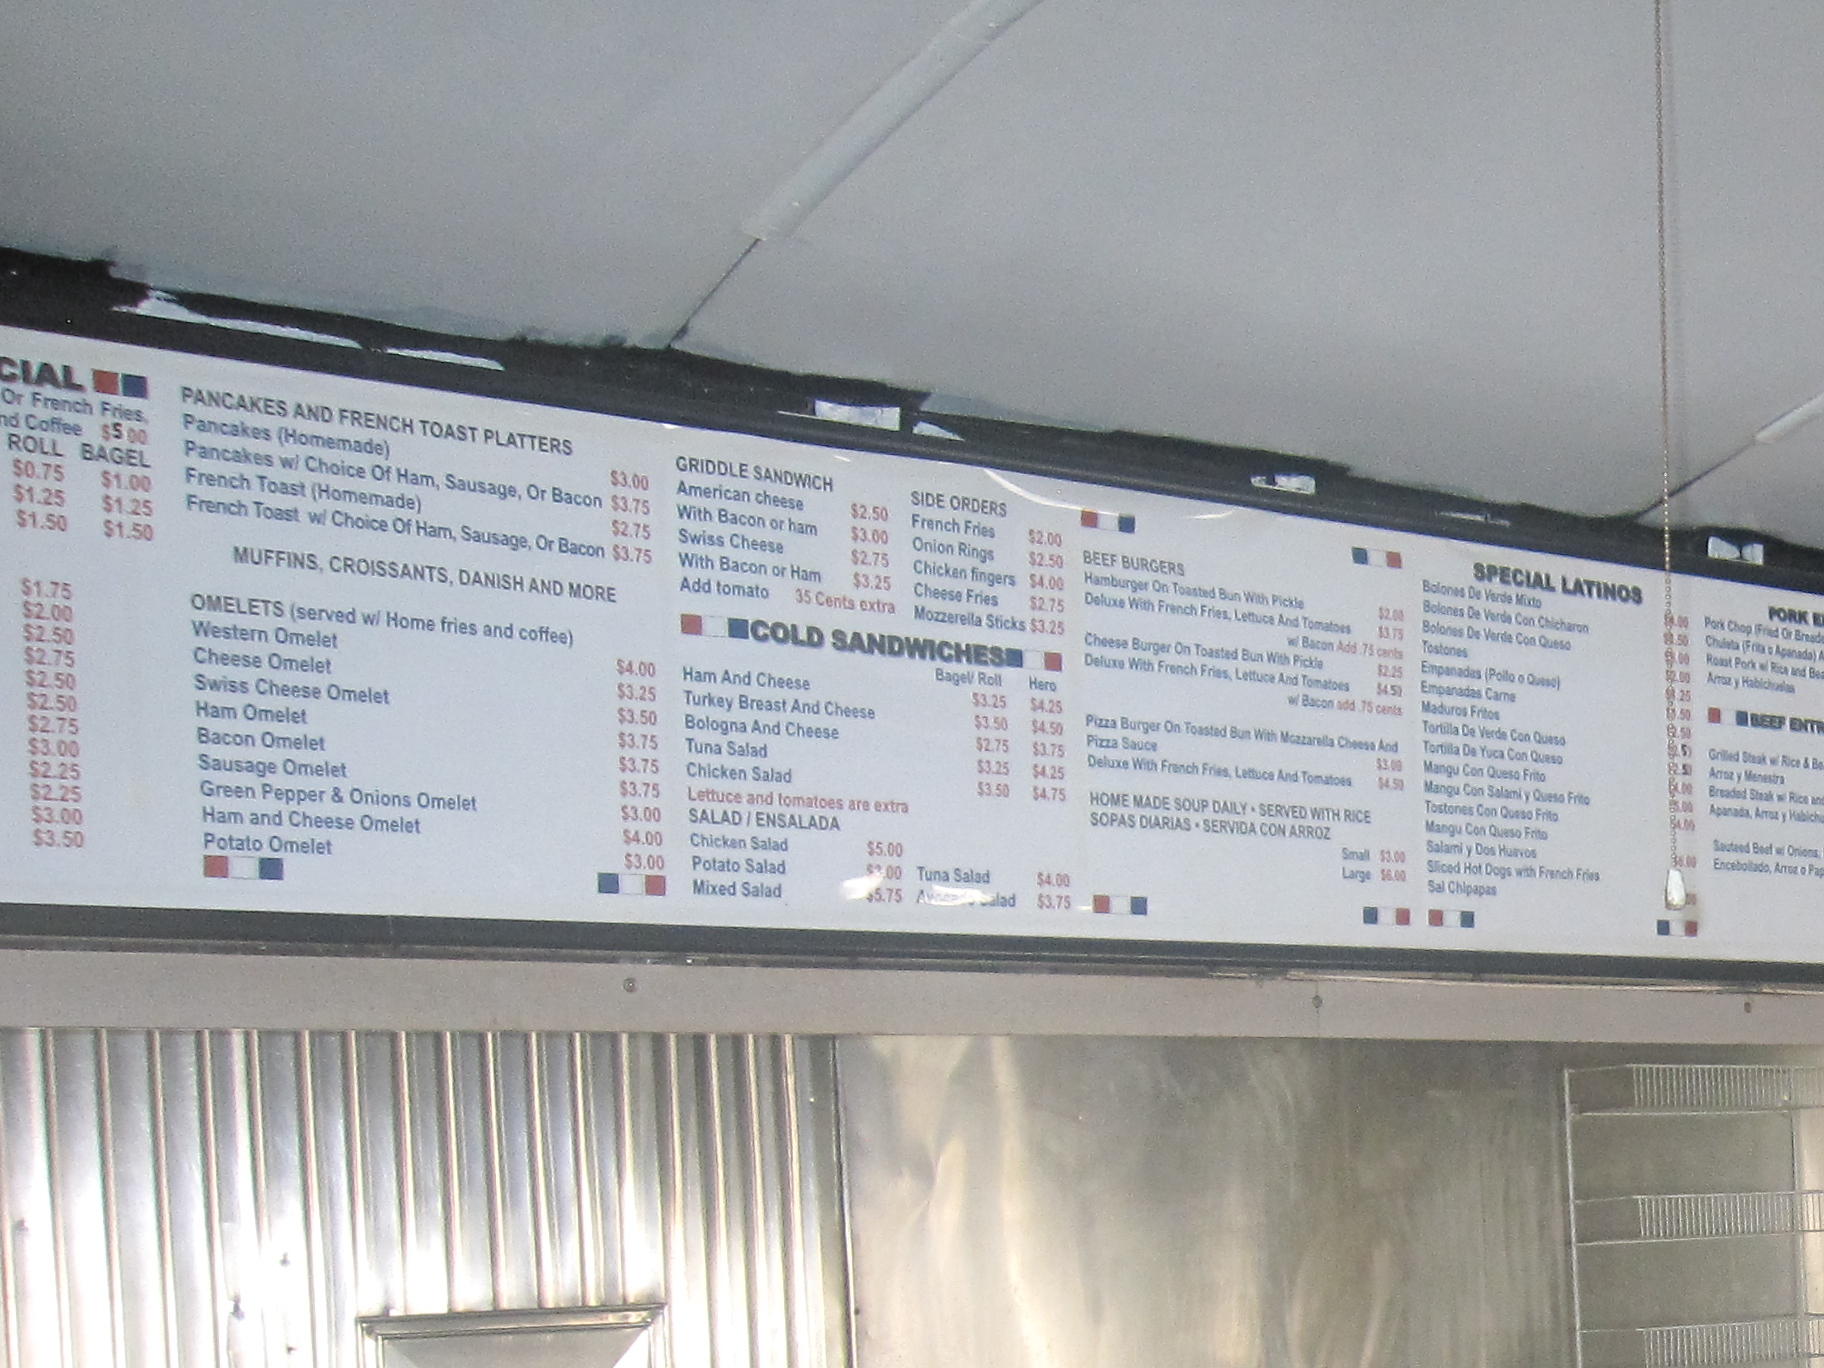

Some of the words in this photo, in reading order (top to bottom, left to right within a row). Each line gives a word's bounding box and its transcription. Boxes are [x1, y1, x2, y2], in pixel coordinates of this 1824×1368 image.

[0, 387, 25, 405] Or
[30, 391, 94, 415] French
[24, 413, 83, 436] Coffee
[180, 386, 289, 417] PANCAKES
[292, 402, 333, 423] AND
[338, 408, 414, 434] FRENCH
[418, 419, 478, 442] TOAST
[483, 428, 573, 456] PLATTERS
[7, 432, 64, 457] ROLL
[80, 442, 151, 468] BAGEL
[182, 413, 273, 441] Pancakes
[277, 427, 390, 459] (Homemade)
[609, 469, 649, 491] $3.00
[12, 458, 65, 482] $0.75
[100, 470, 152, 492] $1.00
[183, 439, 275, 467] Pancakes
[278, 454, 300, 470] w/
[304, 455, 366, 479] Choice
[370, 463, 392, 482] Of
[395, 467, 440, 490] Ham,
[444, 473, 522, 500] Sausage,
[526, 483, 547, 501] Or
[551, 486, 603, 508] Bacon
[610, 494, 650, 515] $3.75
[675, 455, 749, 479] GRIDDLE
[753, 465, 833, 491] SANDWICH
[12, 483, 65, 507] $1.25
[101, 494, 153, 517] $1.25
[184, 466, 252, 490] French
[255, 474, 306, 497] Toast
[311, 482, 422, 513] (Homemade)
[611, 519, 651, 540] $2.75
[676, 480, 751, 502] American
[754, 490, 804, 511] cheese
[850, 502, 889, 522] $2.50
[910, 490, 945, 509] SIDE
[949, 495, 1007, 517] ORDERS
[15, 508, 68, 532] $1.50
[103, 519, 154, 541] $1.50
[911, 513, 960, 533] French
[963, 519, 996, 539] Fries
[1027, 528, 1063, 547] $2.00
[678, 527, 725, 547] Swiss
[729, 533, 784, 554] Cheese
[850, 548, 890, 568] $2.75
[911, 536, 955, 555] Onion
[957, 541, 995, 564] Rings
[1028, 551, 1064, 569] $2.50
[1082, 549, 1117, 567] BEEF
[1121, 555, 1185, 576] BURGERS
[20, 577, 72, 600] $1.75
[232, 546, 323, 571] MUFFINS,
[328, 555, 453, 584] CROISSANTS,
[458, 569, 524, 591] DANISH
[528, 577, 564, 596] AND
[568, 582, 616, 603] MORE
[189, 593, 285, 617] OMELETS
[289, 603, 357, 624] (served
[361, 610, 381, 626] w/
[386, 611, 436, 632] Home
[440, 616, 478, 636] fries
[483, 623, 514, 639] and
[518, 626, 574, 647] coffee)
[190, 620, 269, 642] Western
[274, 626, 338, 648] Omelet
[616, 658, 656, 678] $4.00
[750, 619, 825, 649] COLD
[831, 630, 1006, 667] SANDWICHES
[192, 646, 263, 668] Cheese
[267, 652, 332, 674] Omelet
[617, 682, 656, 702] $3.25
[682, 666, 717, 683] Ham
[720, 669, 752, 686] And
[756, 671, 810, 691] Cheese
[193, 673, 250, 694] Swiss
[254, 677, 322, 699] Cheese
[326, 683, 390, 704] Omelet
[616, 707, 658, 726] $3.50
[195, 700, 238, 719] Ham
[242, 703, 307, 724] Omelet
[617, 731, 659, 750] $3.75
[684, 713, 747, 736] Bologna
[750, 719, 781, 736] And
[785, 721, 839, 740] Cheese
[684, 737, 722, 755] Tuna
[726, 740, 768, 758] Salad
[1086, 733, 1118, 749] Pizza
[1121, 736, 1158, 752] Sauce
[199, 779, 256, 799] Green
[260, 782, 326, 805] Pepper
[330, 786, 344, 804] &
[349, 787, 412, 808] Onions
[416, 792, 477, 811] Omelet
[620, 804, 662, 823] $3.00
[687, 786, 743, 804] Lettuce
[746, 791, 774, 806] and
[777, 793, 844, 810] tomatoes
[847, 799, 870, 812] are
[873, 800, 909, 814] extra
[1089, 791, 1129, 808] HOME
[1132, 794, 1171, 811] MADE
[1173, 797, 1209, 813] SOUP
[1211, 799, 1247, 815] DAILY
[1258, 803, 1308, 819] SERVED
[1309, 807, 1341, 821] WITH
[1343, 808, 1371, 824] RICE
[201, 805, 244, 824] Ham
[249, 810, 283, 827] and
[287, 810, 355, 830] Cheese
[359, 814, 420, 834] Omelet
[622, 828, 663, 847] $4.00
[688, 807, 743, 826] SALAD
[755, 811, 841, 831] ENSALADA
[1090, 811, 1136, 828] SOPAS
[1139, 814, 1192, 831] DIARIAS
[1202, 818, 1257, 835] SERVIDA
[1259, 822, 1286, 837] CON
[1288, 824, 1331, 840] ARROZ
[32, 828, 85, 848] $3.50
[203, 831, 263, 853] Potato
[268, 835, 332, 856] Omelet
[624, 852, 665, 871] $3.00
[1341, 847, 1371, 862] Small
[1379, 849, 1406, 864] $3.00
[1341, 866, 1372, 883] Large
[1379, 868, 1407, 882] $6.00
